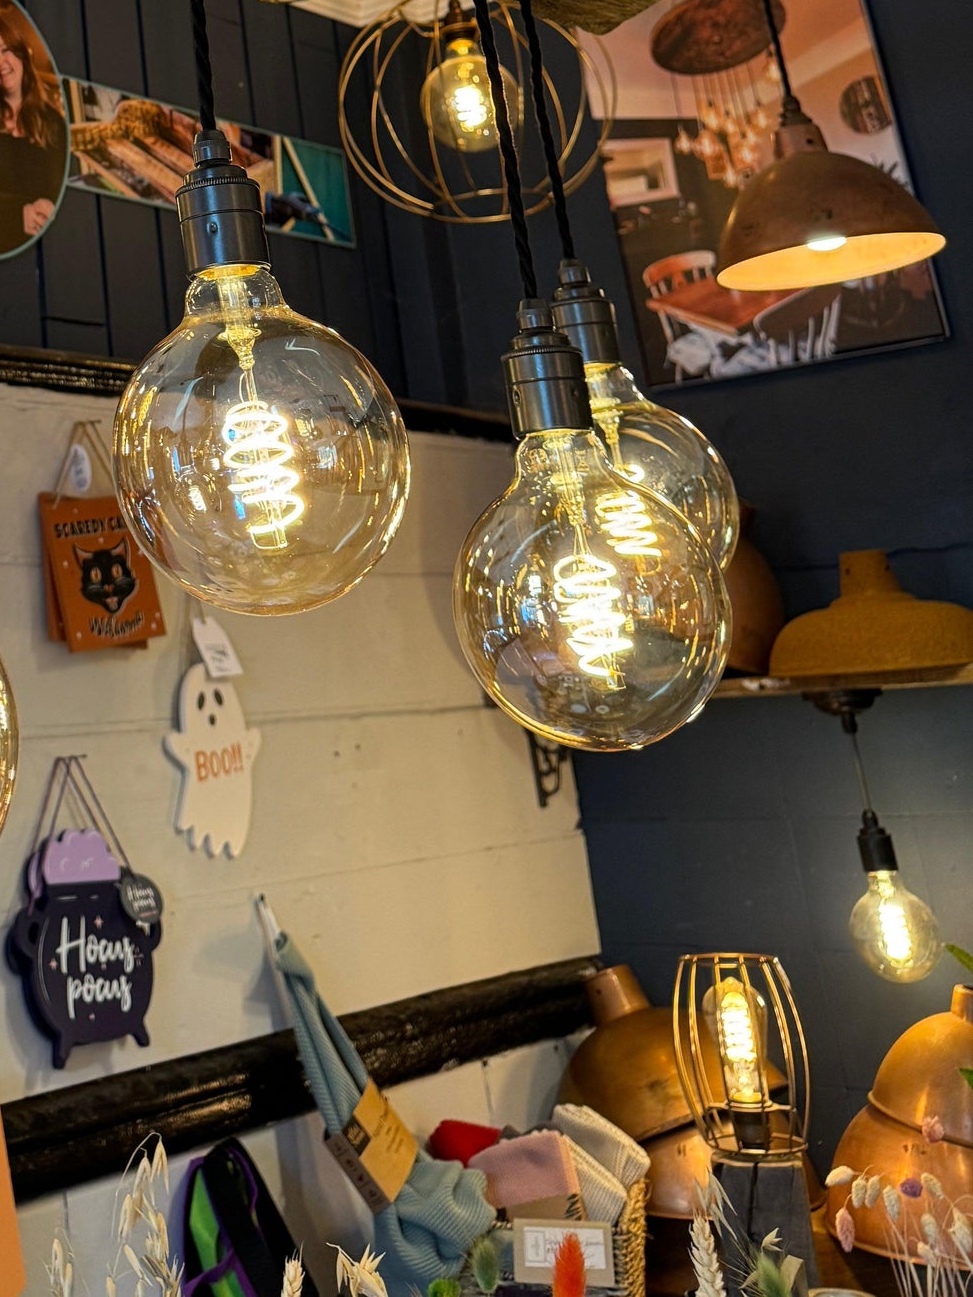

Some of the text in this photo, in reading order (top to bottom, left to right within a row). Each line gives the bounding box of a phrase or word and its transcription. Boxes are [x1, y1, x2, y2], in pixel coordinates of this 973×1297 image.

[107, 515, 127, 532] CA
[195, 742, 244, 782] BOO!!
[56, 915, 135, 974] Hocus
[66, 973, 133, 1019] pocus
